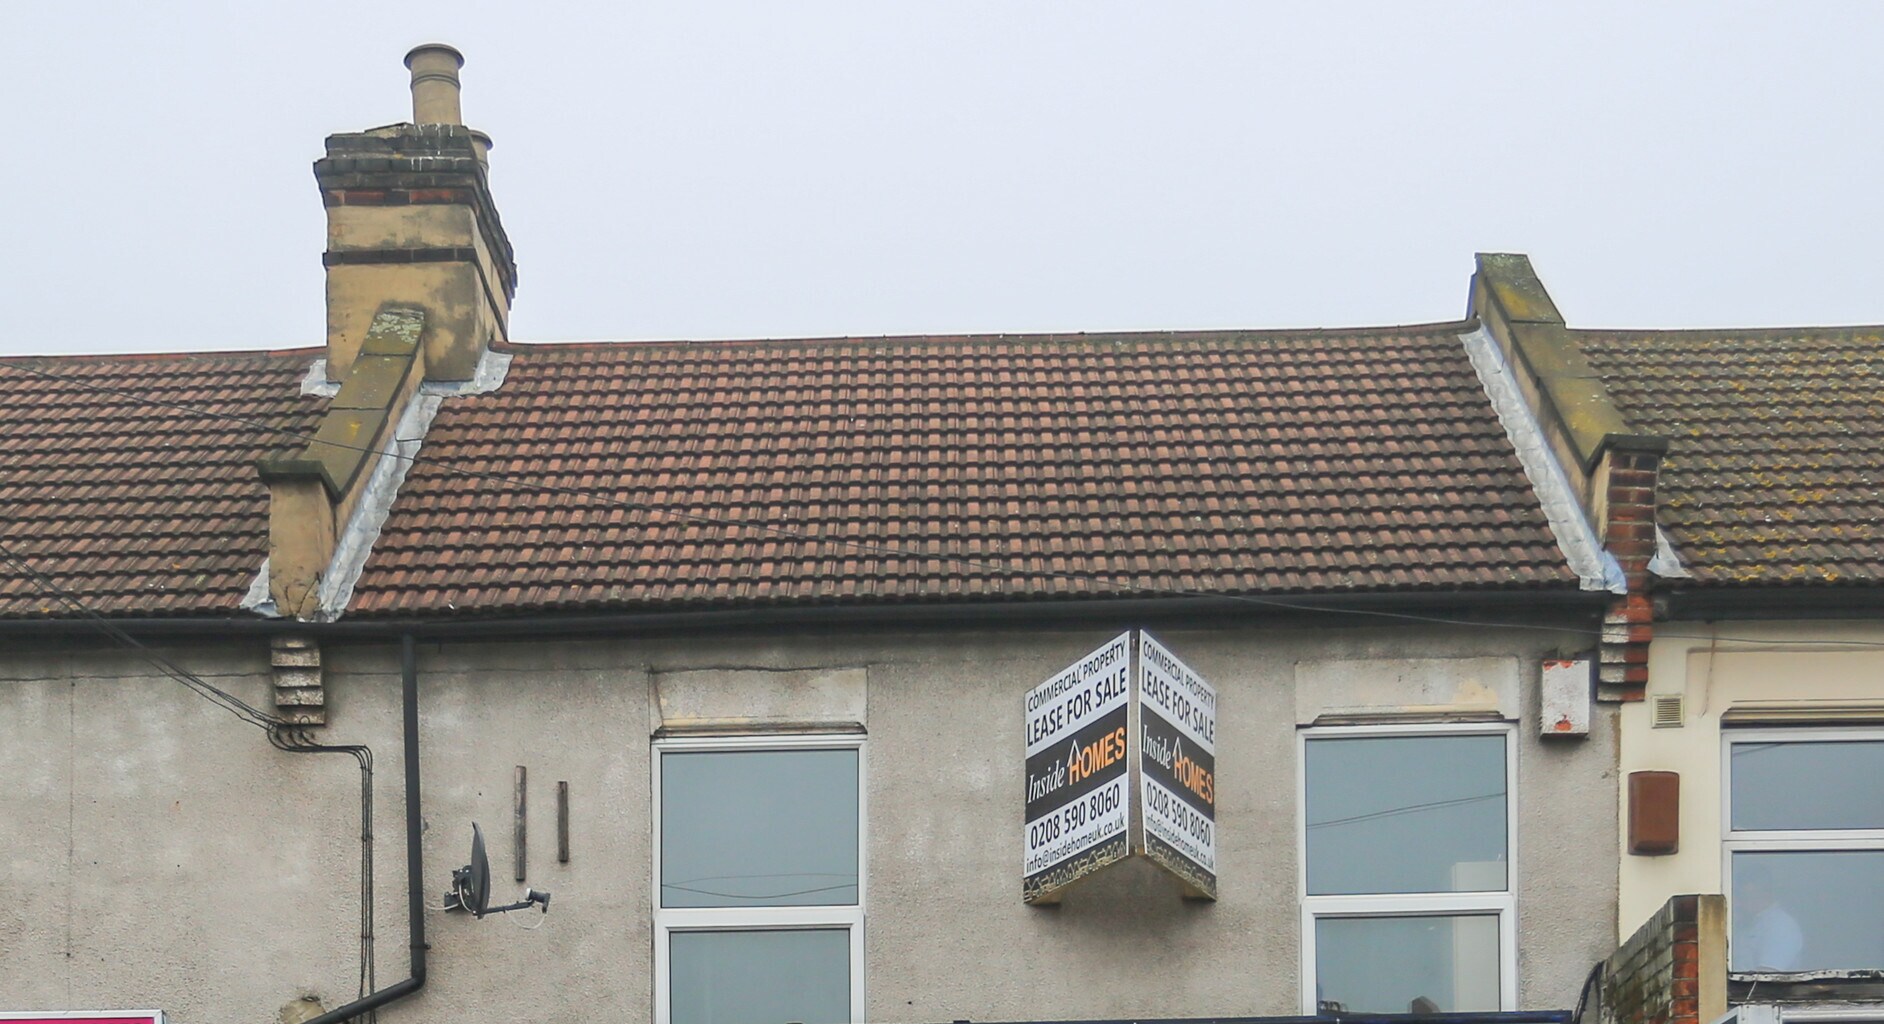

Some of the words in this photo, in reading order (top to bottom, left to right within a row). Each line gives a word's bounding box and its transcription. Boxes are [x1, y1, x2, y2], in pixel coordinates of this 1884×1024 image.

[1027, 704, 1063, 747] LEASE
[1067, 689, 1092, 724] FOR
[1095, 667, 1126, 708] SALE
[1028, 668, 1082, 713] COMMERCIAL
[1083, 641, 1125, 680] PROPERTY
[1142, 665, 1170, 710] LEASE
[1172, 690, 1191, 728] FOR
[1193, 704, 1214, 744] SALE
[1143, 640, 1184, 686] COMMERCIAL
[1185, 674, 1215, 710] PROPERTY
[1027, 759, 1065, 804] Inside
[1067, 726, 1126, 786] HOMES
[1142, 724, 1172, 770] Inside
[1172, 736, 1213, 805] HOMES
[1026, 815, 1125, 874] info@insidehomeuk.co.uk
[1030, 814, 1061, 850] 0208
[1064, 802, 1086, 836] 590
[1089, 783, 1121, 820] 8060
[1146, 781, 1170, 820] 0208
[1172, 797, 1188, 833] 590
[1189, 810, 1211, 850] 8060
